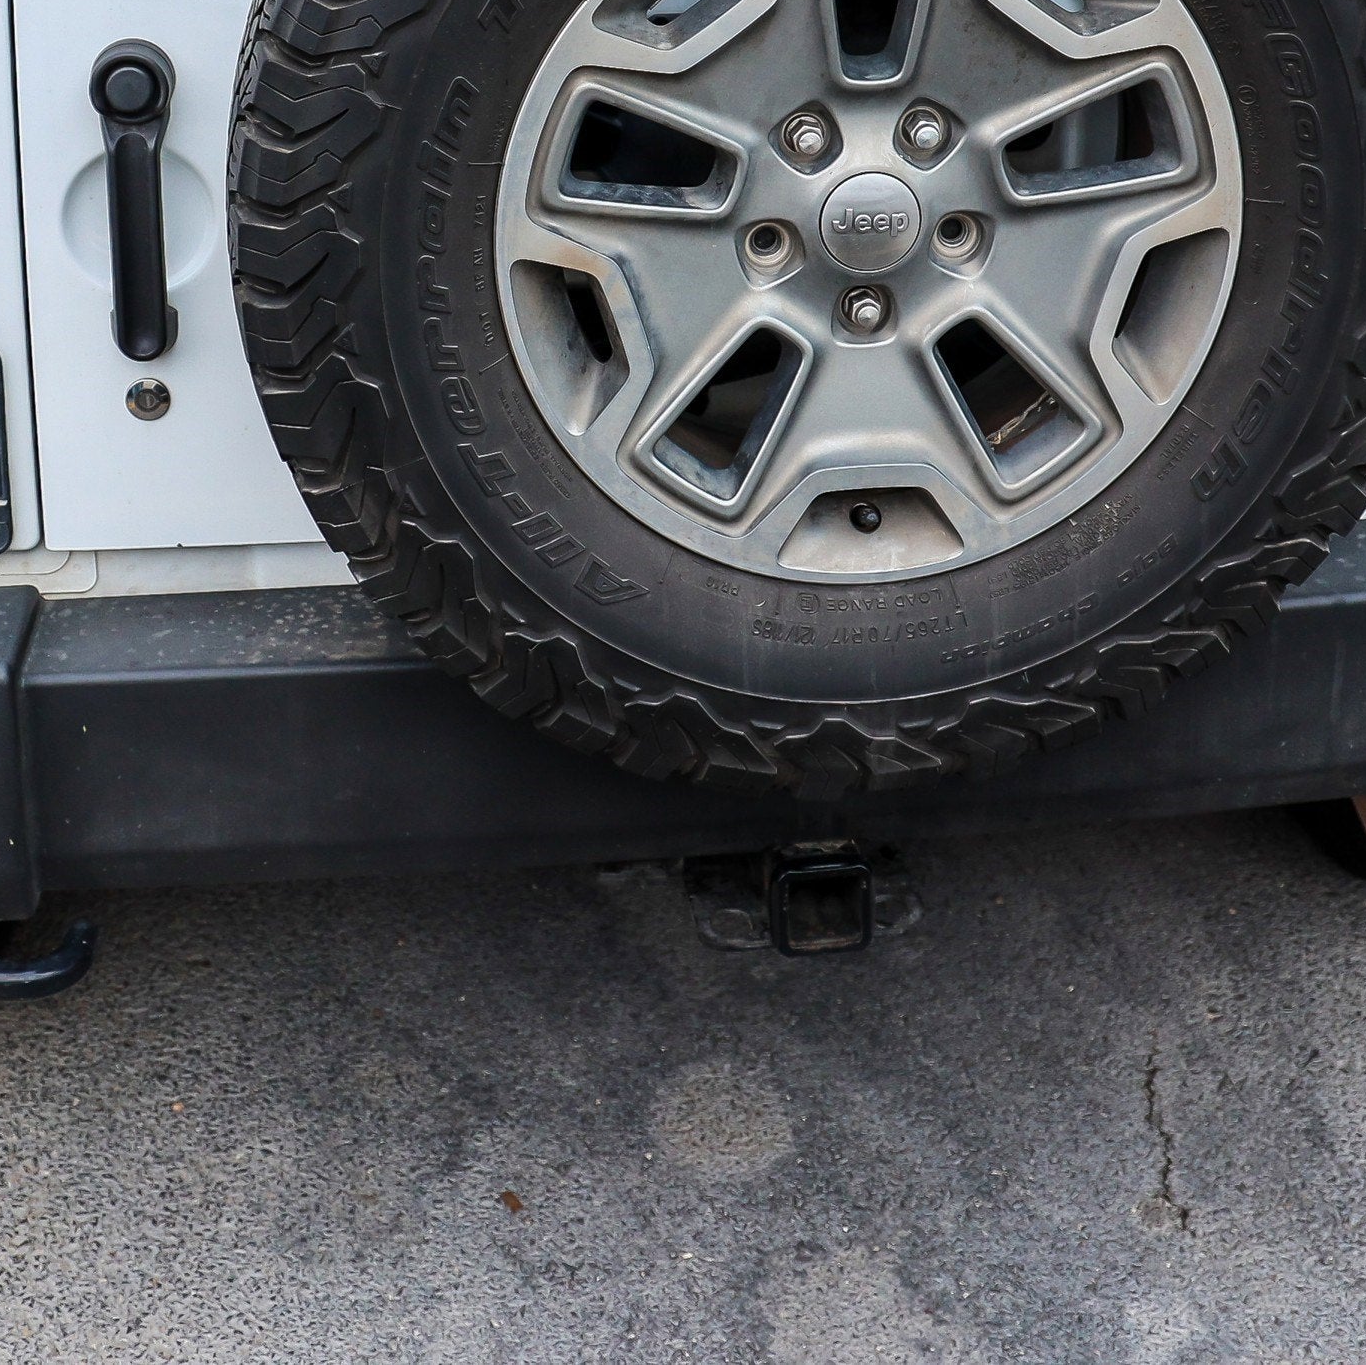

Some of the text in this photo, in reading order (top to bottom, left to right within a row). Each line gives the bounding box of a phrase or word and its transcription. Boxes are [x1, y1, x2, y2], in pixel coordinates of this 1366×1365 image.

[830, 207, 909, 237] Jeep
[417, 75, 651, 605] All-Terrain
[1115, 532, 1179, 589] Baja
[826, 597, 888, 613] RANGE
[894, 588, 943, 610] LOAD
[939, 591, 1099, 663] Champion
